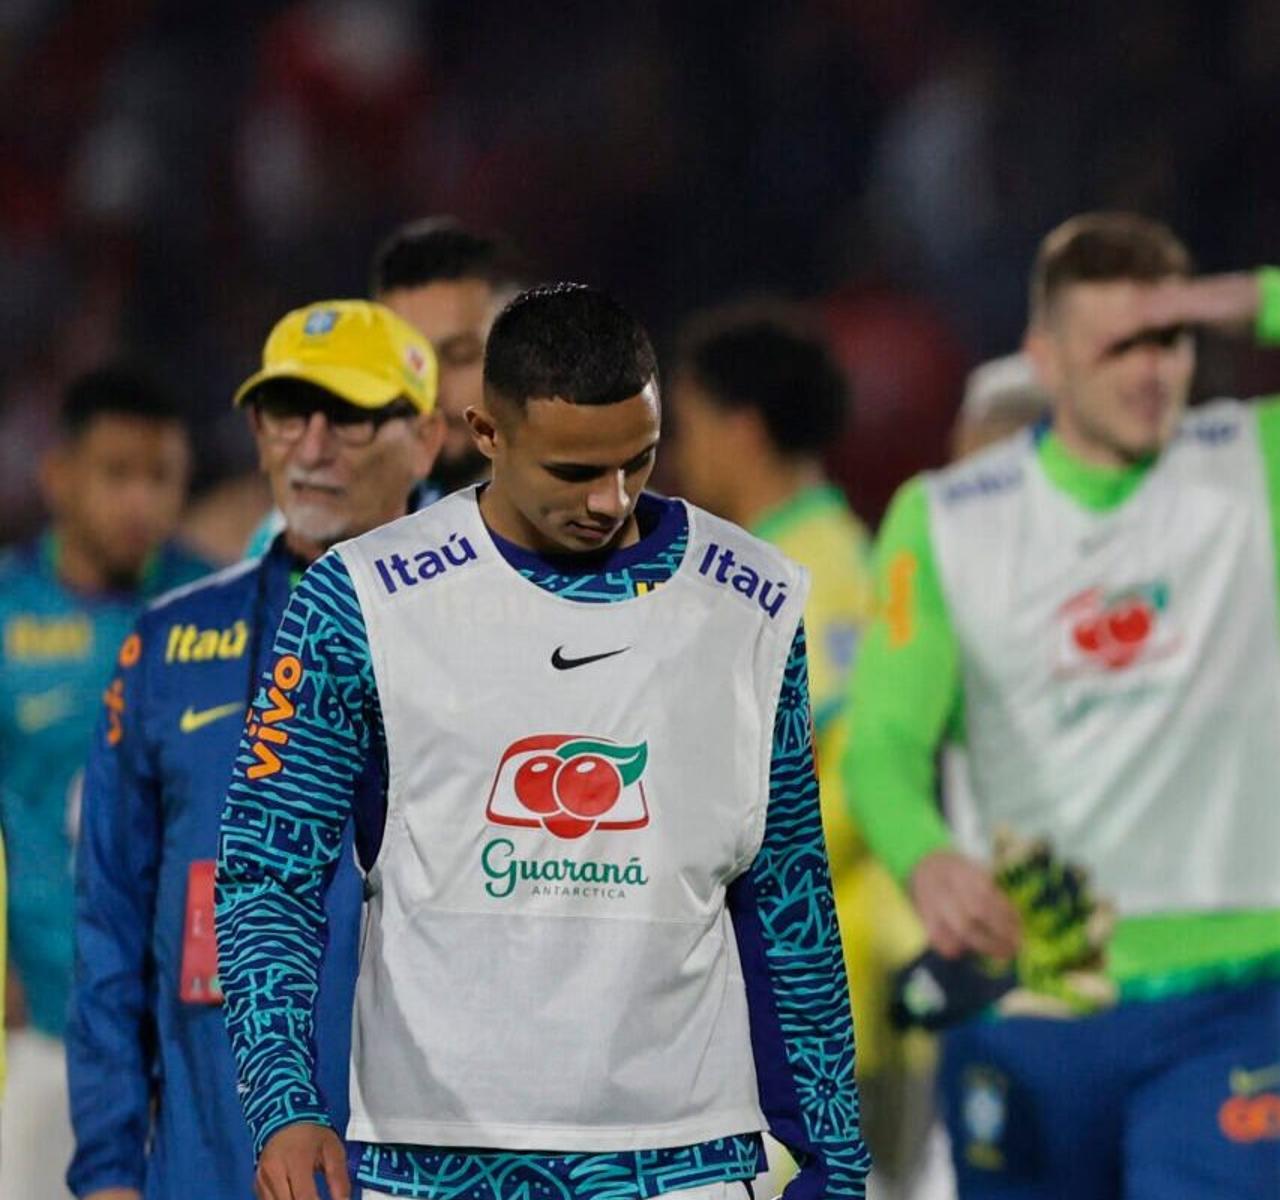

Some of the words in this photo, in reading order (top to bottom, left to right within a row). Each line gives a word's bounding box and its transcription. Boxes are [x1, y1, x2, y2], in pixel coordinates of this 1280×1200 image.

[374, 532, 479, 594] Itaú
[698, 542, 788, 619] Itaú
[165, 619, 249, 664] Itaú
[247, 655, 302, 779] vivo
[481, 838, 649, 898] Guaraná
[532, 886, 627, 899] ANTARCTICA
